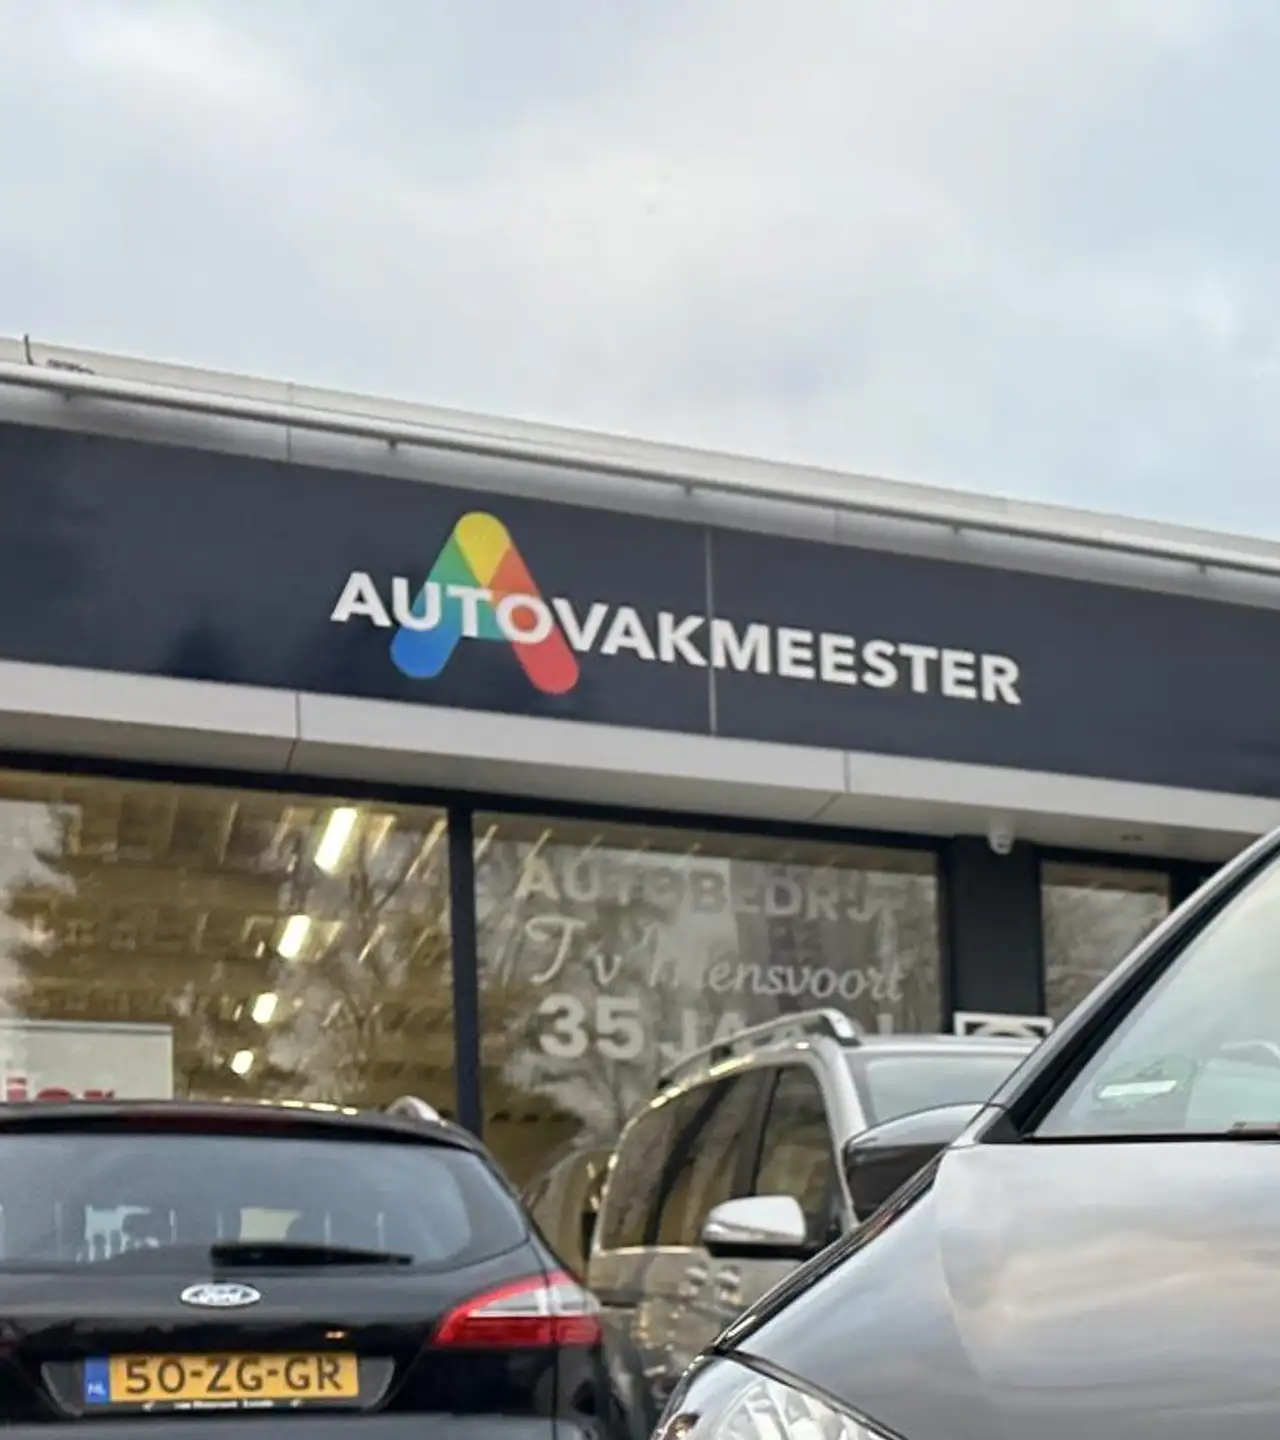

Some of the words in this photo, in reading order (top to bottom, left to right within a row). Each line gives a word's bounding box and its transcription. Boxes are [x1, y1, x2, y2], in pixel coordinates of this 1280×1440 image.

[330, 571, 1021, 704] AUTOVAKMEESTER
[538, 992, 647, 1060] 35
[126, 1355, 343, 1395] 50-ZG-GR
